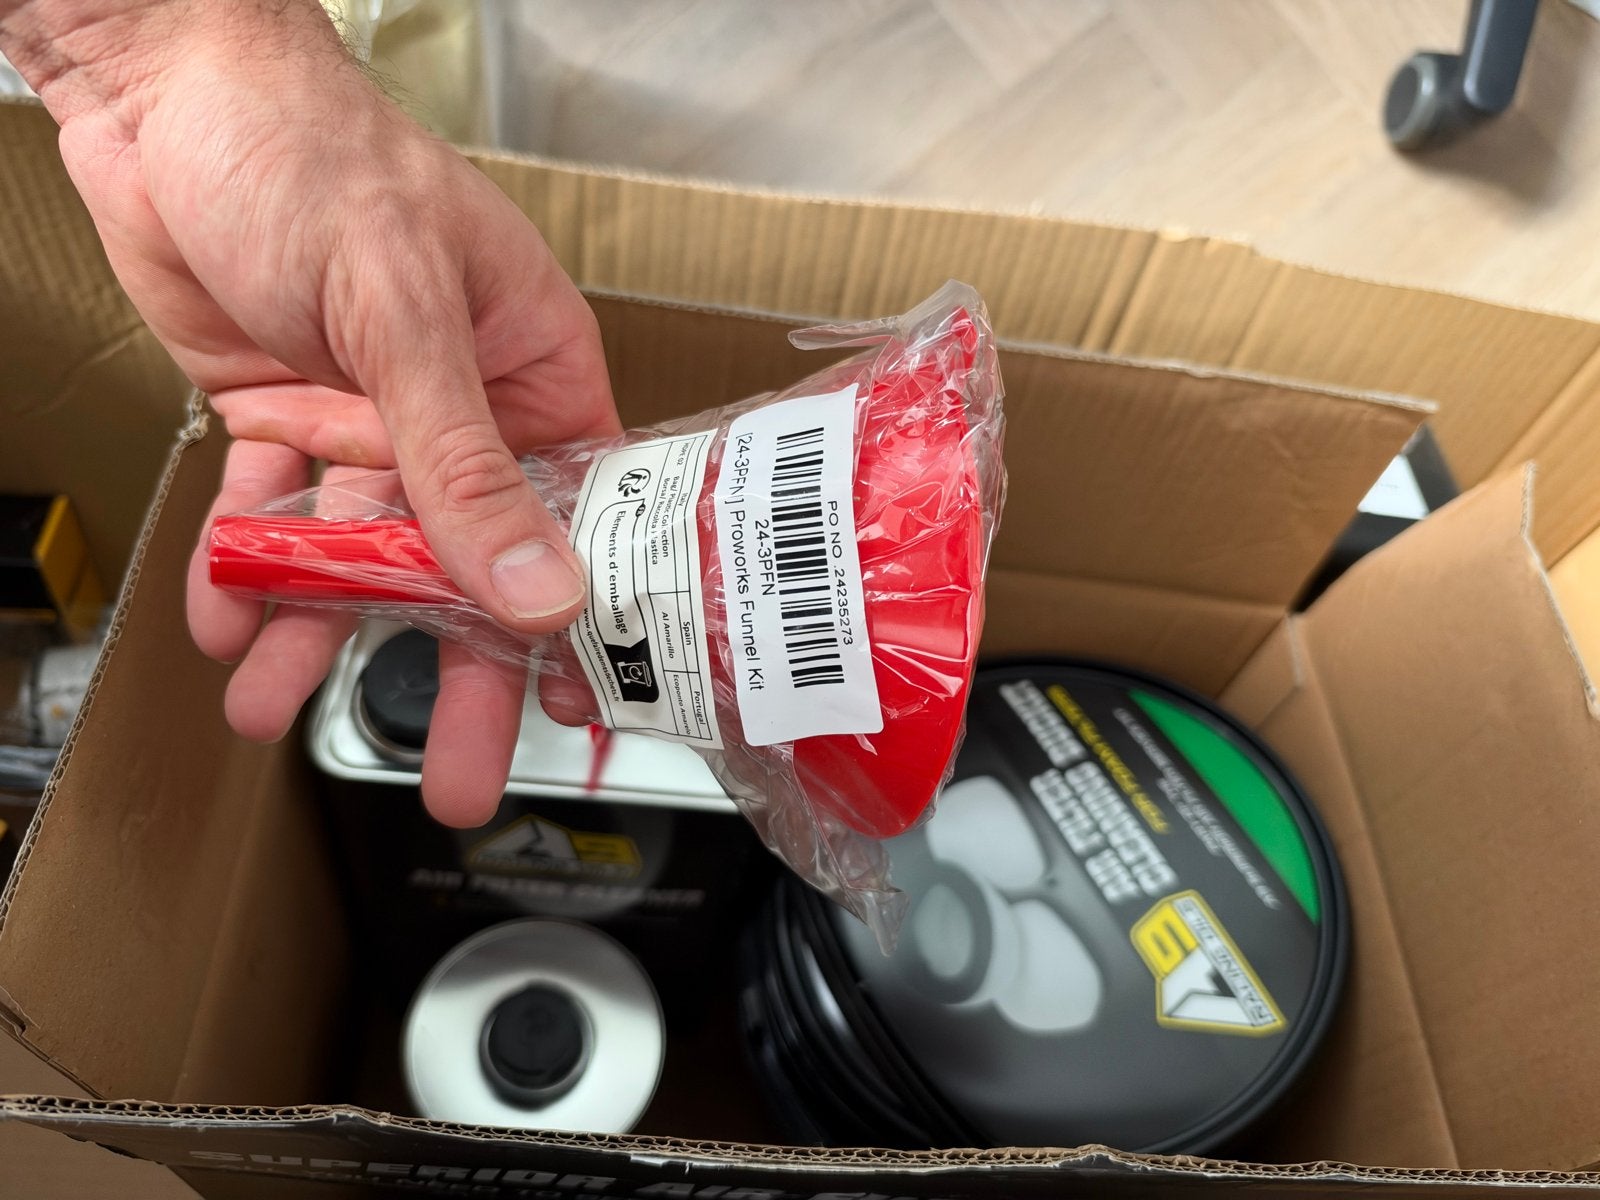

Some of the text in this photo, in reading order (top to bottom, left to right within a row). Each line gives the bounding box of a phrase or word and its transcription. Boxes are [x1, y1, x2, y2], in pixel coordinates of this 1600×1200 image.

[651, 500, 664, 529] Raccolta
[665, 492, 676, 514] Plastic
[678, 492, 688, 506] Italy
[827, 501, 839, 526] PO
[609, 511, 626, 558] Elements
[830, 532, 843, 559] NO
[724, 432, 764, 691] [24-3PFN] Proworks Funnel Kit
[755, 519, 776, 595] 24-3PFN
[664, 623, 675, 659] Amarillo
[683, 621, 692, 646] Spain
[673, 674, 691, 735] Ecoponto Amarelo
[694, 690, 705, 725] Portugal
[999, 679, 1178, 893] CLEANING BUCKET
[1029, 768, 1140, 903] AIR FILTER
[189, 1150, 616, 1190] SUPERIOR
